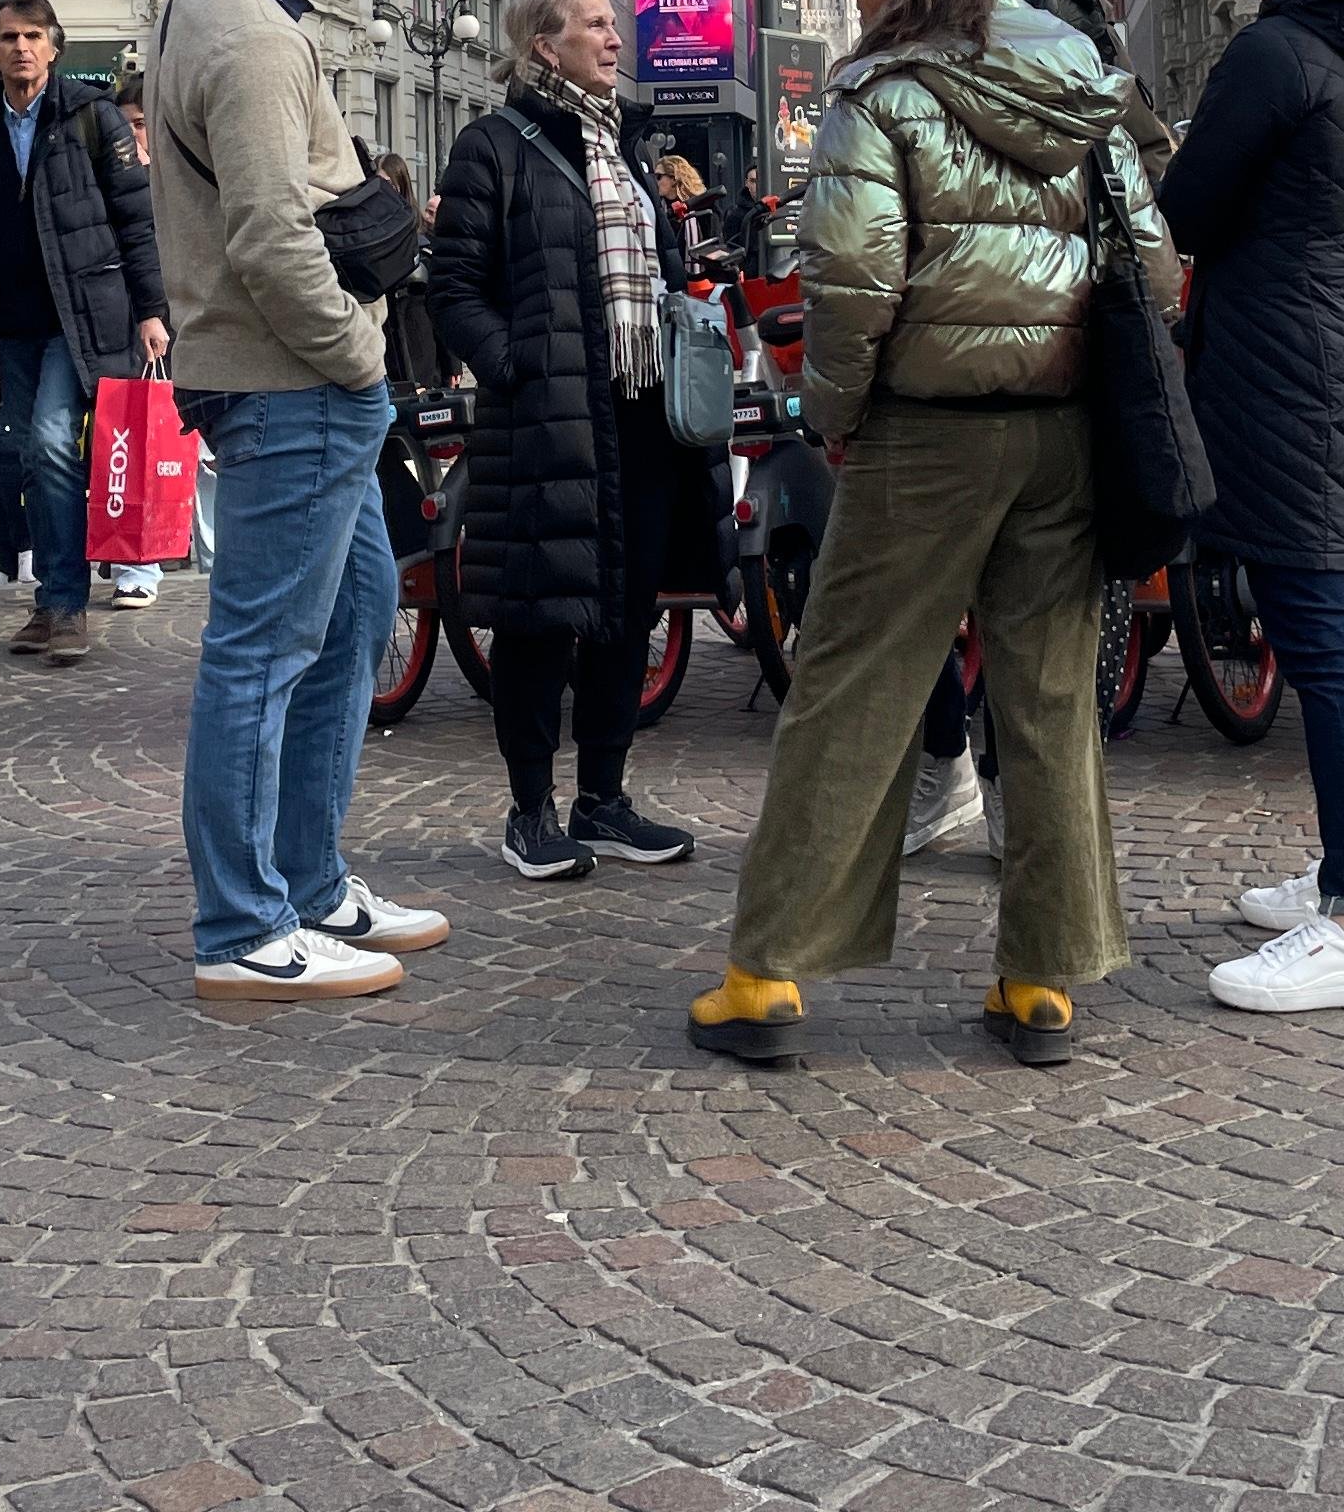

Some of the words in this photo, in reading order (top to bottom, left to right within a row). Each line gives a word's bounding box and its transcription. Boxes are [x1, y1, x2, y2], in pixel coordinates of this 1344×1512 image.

[658, 92, 684, 100] URBAN
[687, 91, 714, 100] VISION
[107, 428, 130, 518] GEOX
[157, 461, 182, 477] GEOX
